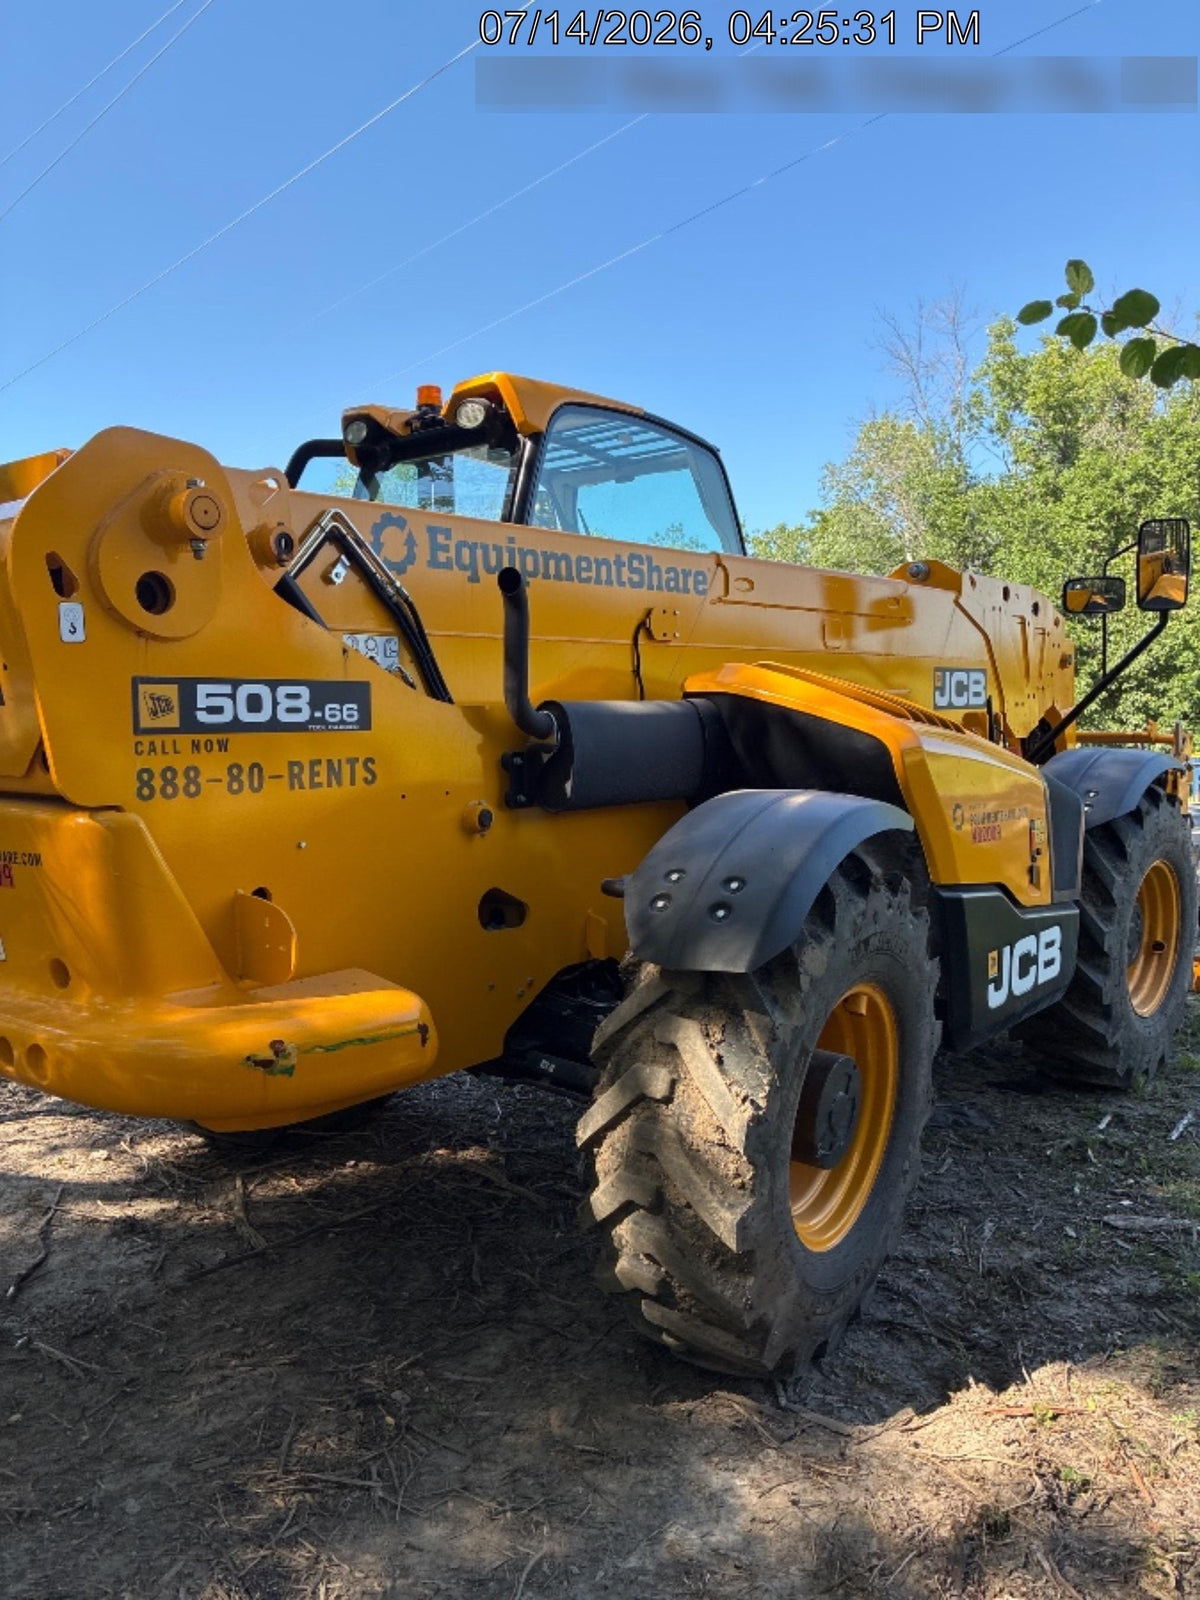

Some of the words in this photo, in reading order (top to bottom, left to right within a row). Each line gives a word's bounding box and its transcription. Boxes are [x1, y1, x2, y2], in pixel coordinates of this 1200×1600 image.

[426, 524, 709, 596] EquipmentShare
[934, 671, 986, 706] JCB
[134, 740, 181, 757] CALL
[191, 738, 230, 753] NOW
[135, 756, 378, 801] 888-80-RENTS
[987, 925, 1061, 1009] JCB
